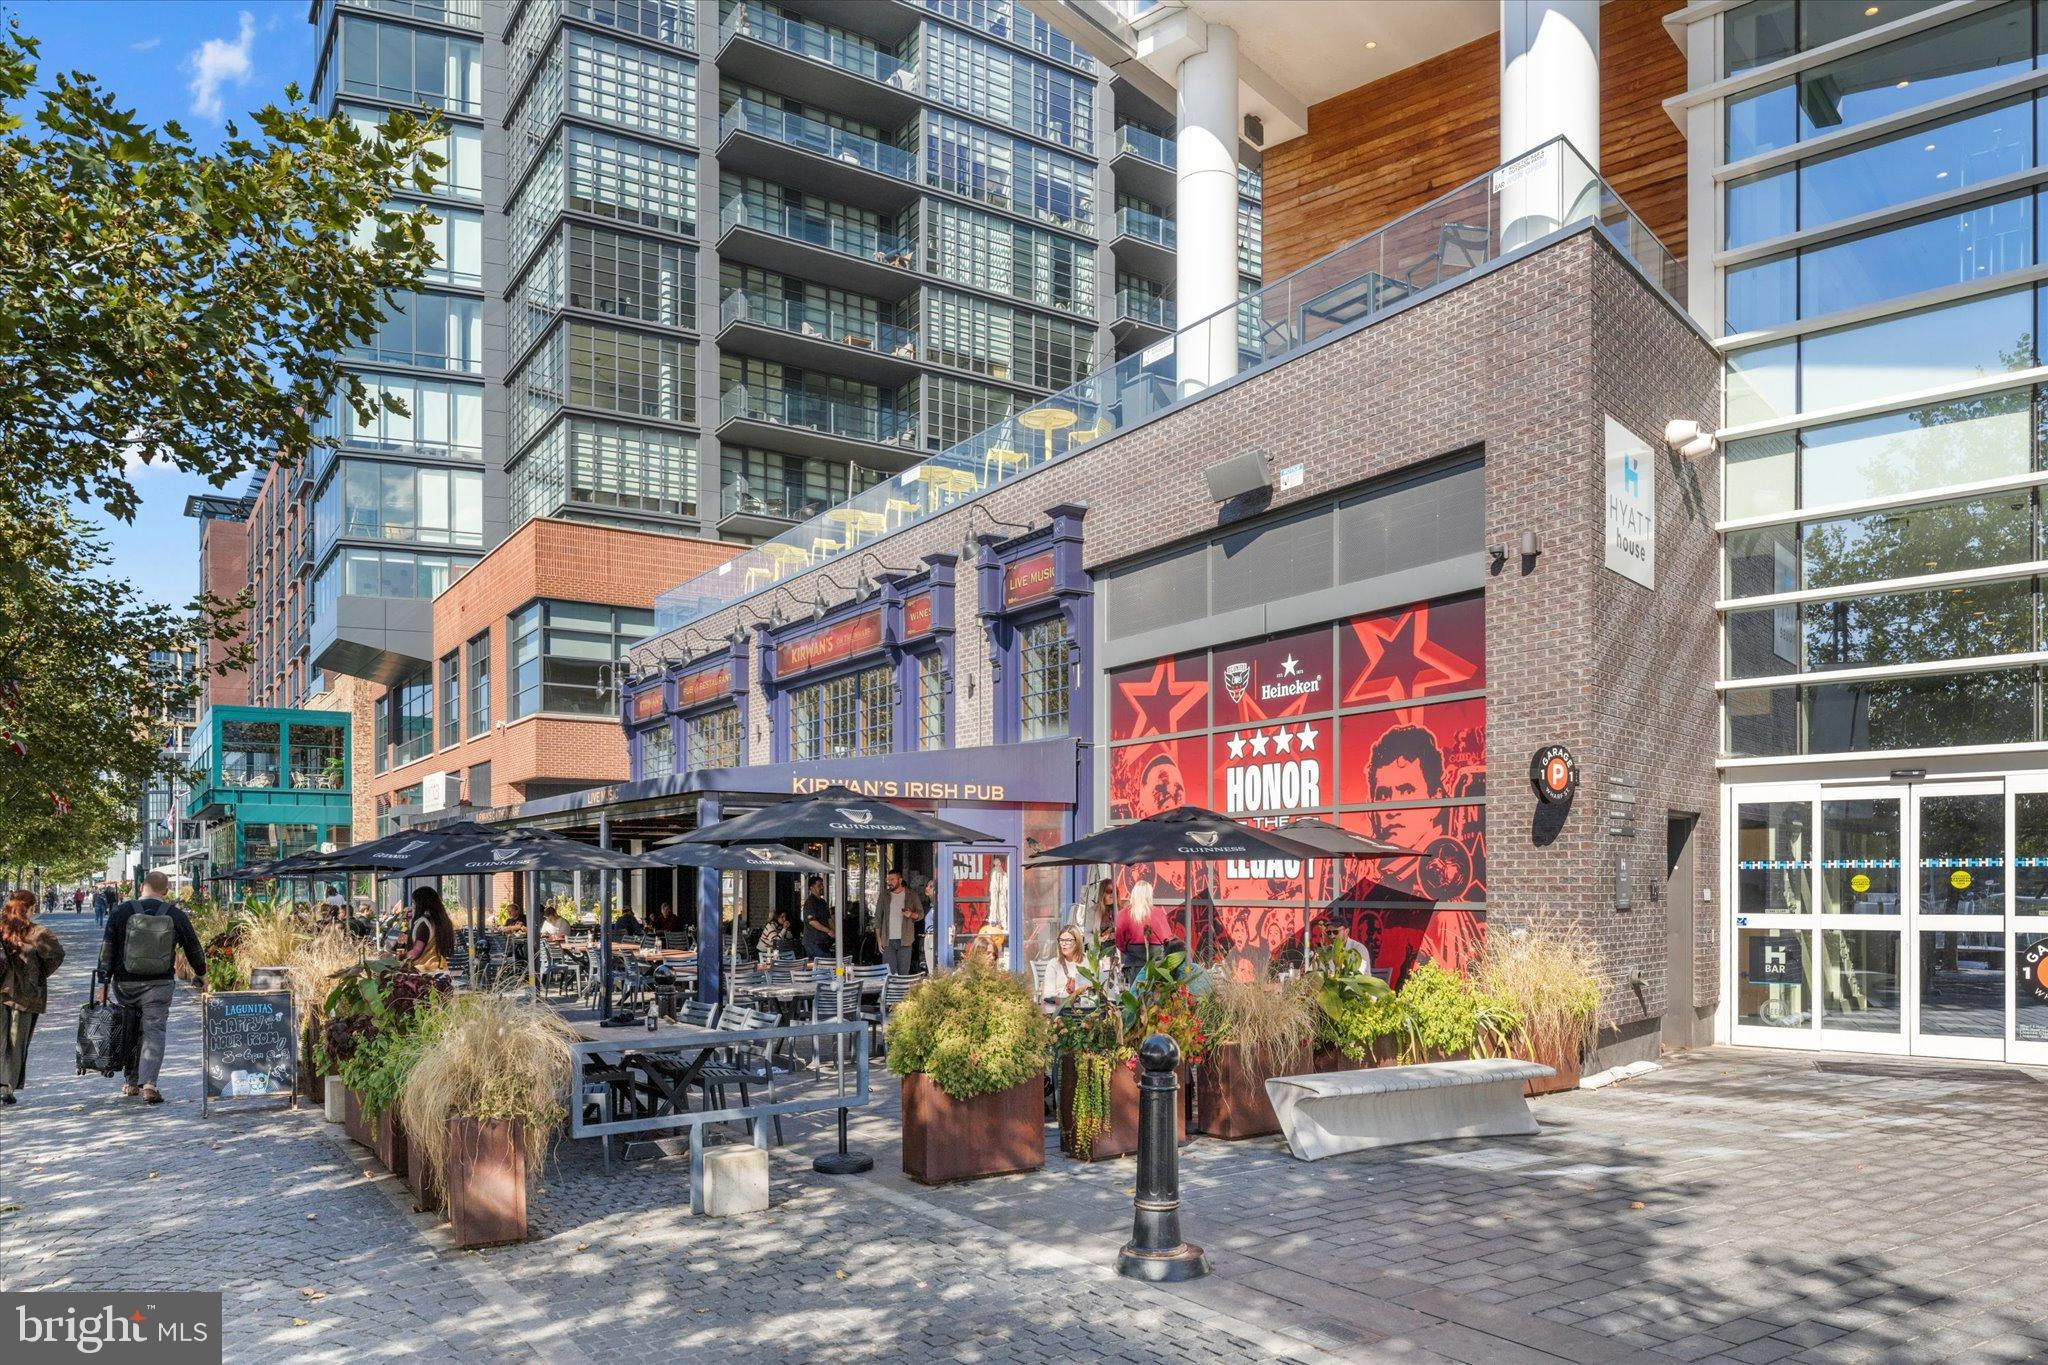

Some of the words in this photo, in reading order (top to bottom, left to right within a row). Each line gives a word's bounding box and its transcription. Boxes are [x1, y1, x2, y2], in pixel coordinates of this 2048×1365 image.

[1609, 494, 1651, 541] HYATT
[1616, 527, 1646, 562] house
[1009, 575, 1029, 590] LIVE
[791, 636, 833, 664] KIRWAN'S
[1261, 679, 1320, 700] Heineken
[1542, 747, 1573, 768] GARAGE
[1540, 769, 1545, 780] 1
[1552, 763, 1565, 785] P
[1569, 771, 1573, 782] 1
[904, 781, 958, 799] IRISH
[964, 784, 1004, 800] PUB
[1226, 759, 1320, 813] HONOR
[829, 822, 906, 831] GUINNESS
[1252, 816, 1290, 829] THE
[1764, 964, 1786, 974] BAR
[2022, 966, 2031, 980] 1
[225, 1003, 273, 1016] LAGUNITAS
[209, 1015, 265, 1036] HAPPY
[210, 1033, 243, 1051] HOUR
